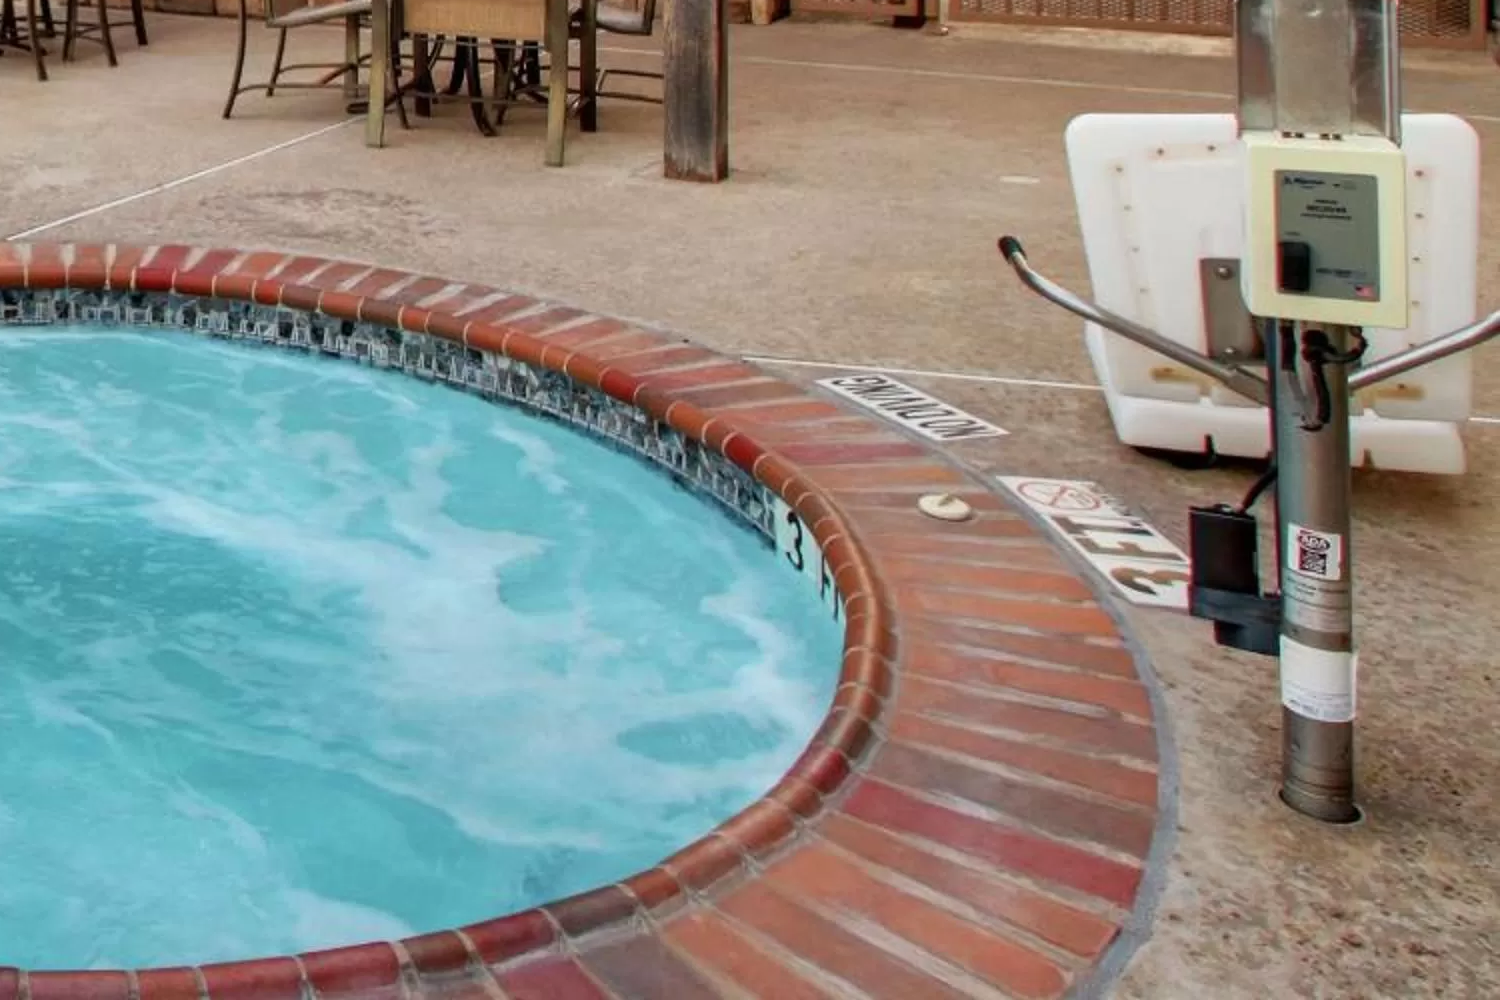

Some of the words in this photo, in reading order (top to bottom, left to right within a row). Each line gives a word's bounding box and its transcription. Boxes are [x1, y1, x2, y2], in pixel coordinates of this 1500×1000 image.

[831, 376, 957, 419] DIVING
[918, 419, 993, 438] NO
[785, 511, 804, 571] 3
[1050, 515, 1184, 562] FT
